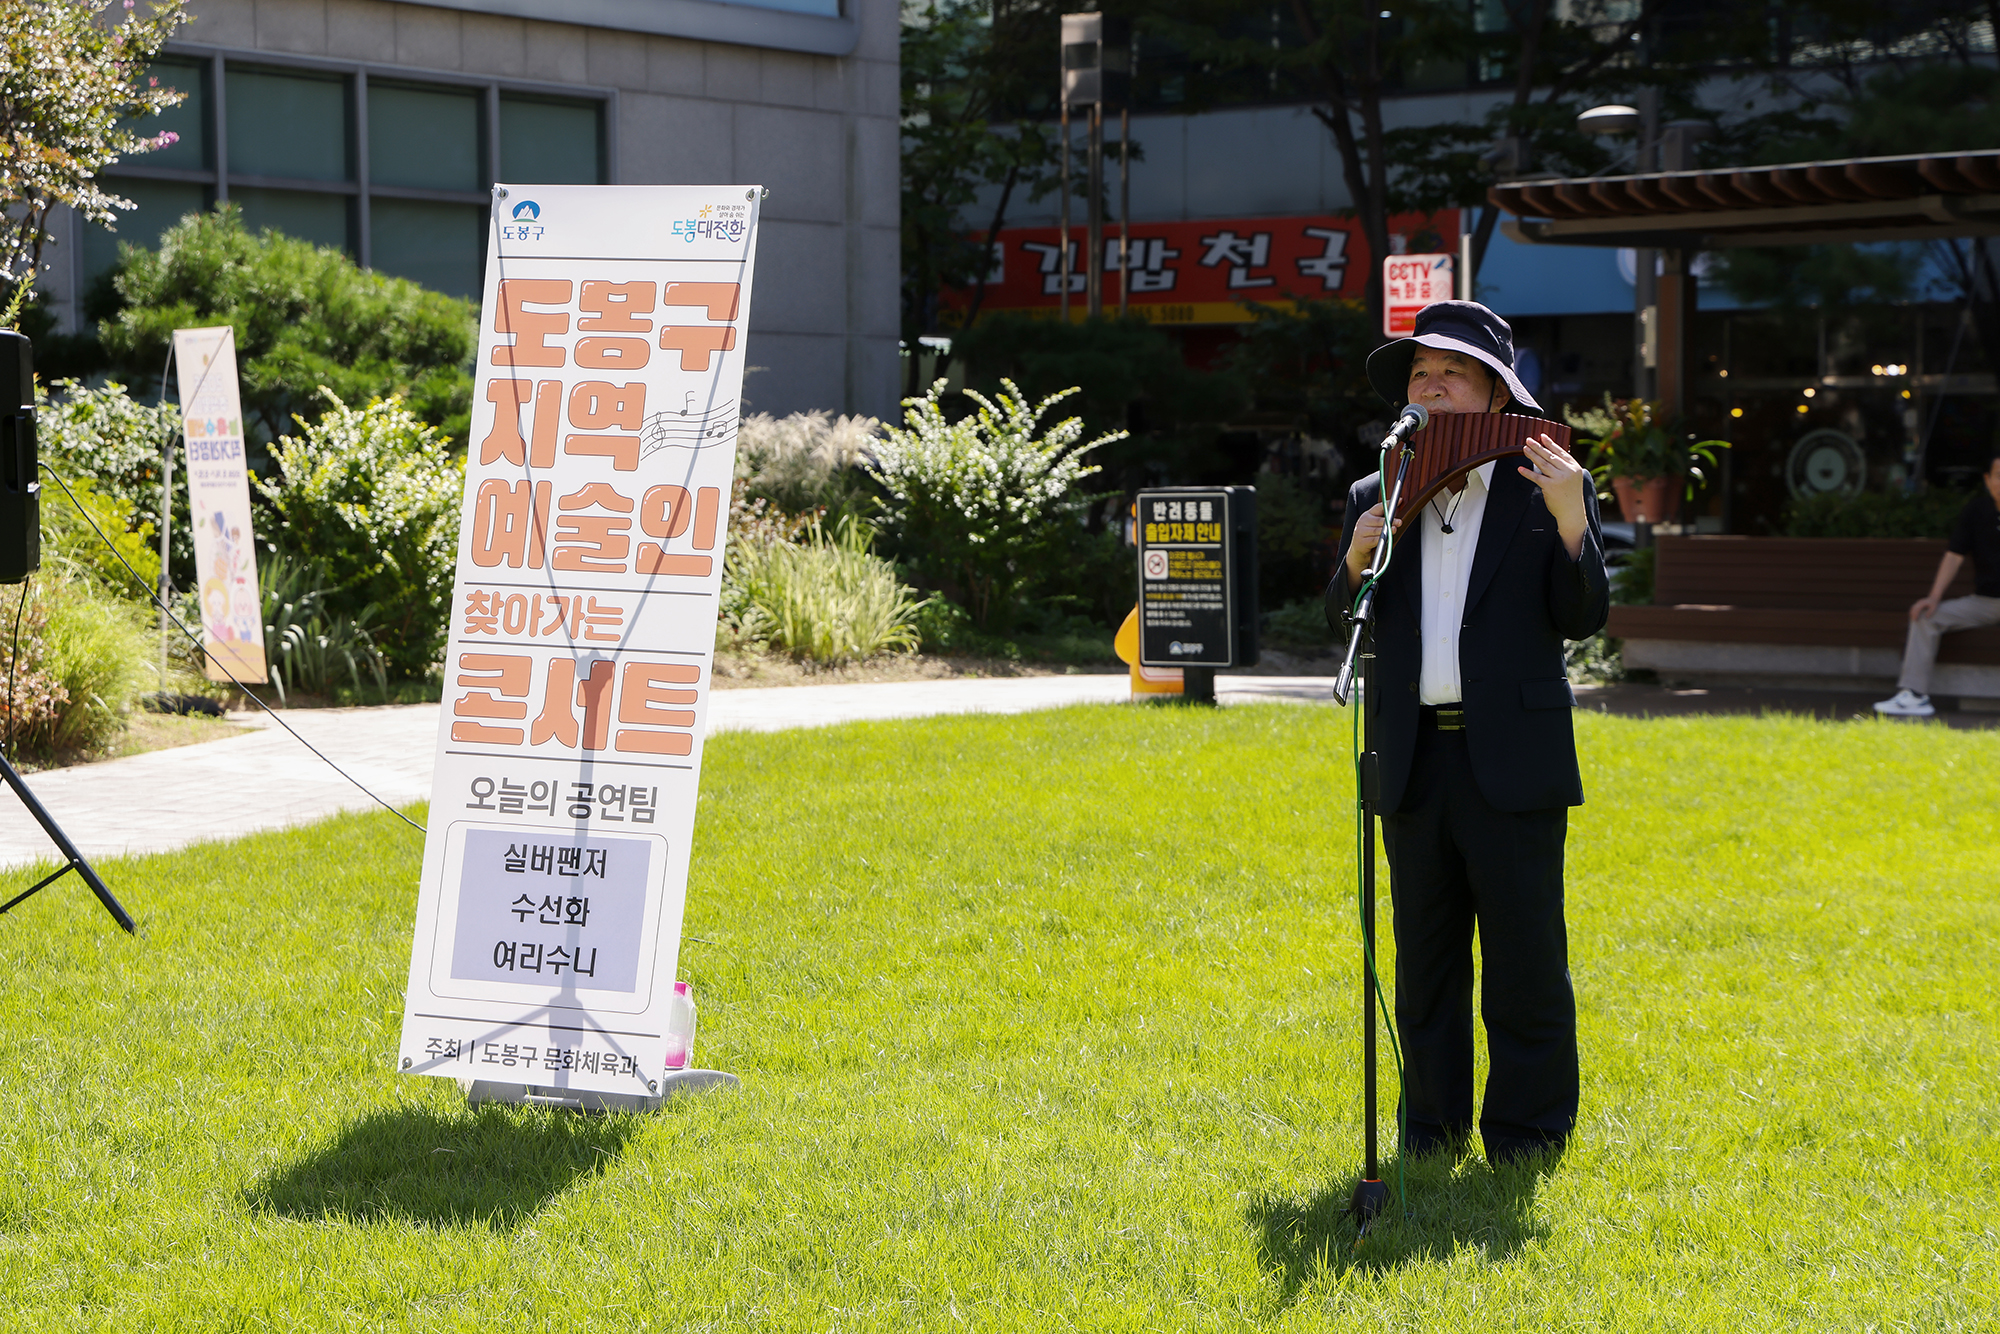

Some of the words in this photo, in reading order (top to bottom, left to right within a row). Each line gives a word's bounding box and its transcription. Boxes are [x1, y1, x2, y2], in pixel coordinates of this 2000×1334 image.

[502, 225, 546, 241] 도봉구
[671, 219, 746, 242] 도봉대전환
[1021, 226, 1348, 294] 김밥천국
[1389, 261, 1431, 280] CCTV
[1389, 282, 1431, 299] 녹화중
[491, 278, 741, 372] 도봉구
[480, 378, 647, 471] 지역
[471, 478, 720, 577] 예술인
[1153, 501, 1213, 521] 반려동물
[1145, 522, 1195, 542] 출입자제
[1196, 522, 1221, 542] 안내
[464, 590, 624, 641] 찾아가는
[451, 653, 701, 756] 콘서트
[466, 776, 559, 817] 오늘의
[566, 781, 658, 824] 공연팀
[503, 843, 608, 879] 실버팬저
[511, 893, 590, 927] 수선화
[493, 940, 598, 978] 여리수니
[425, 1037, 462, 1062] 주최
[481, 1042, 538, 1069] 도봉구
[543, 1048, 639, 1078] 문화체육과
